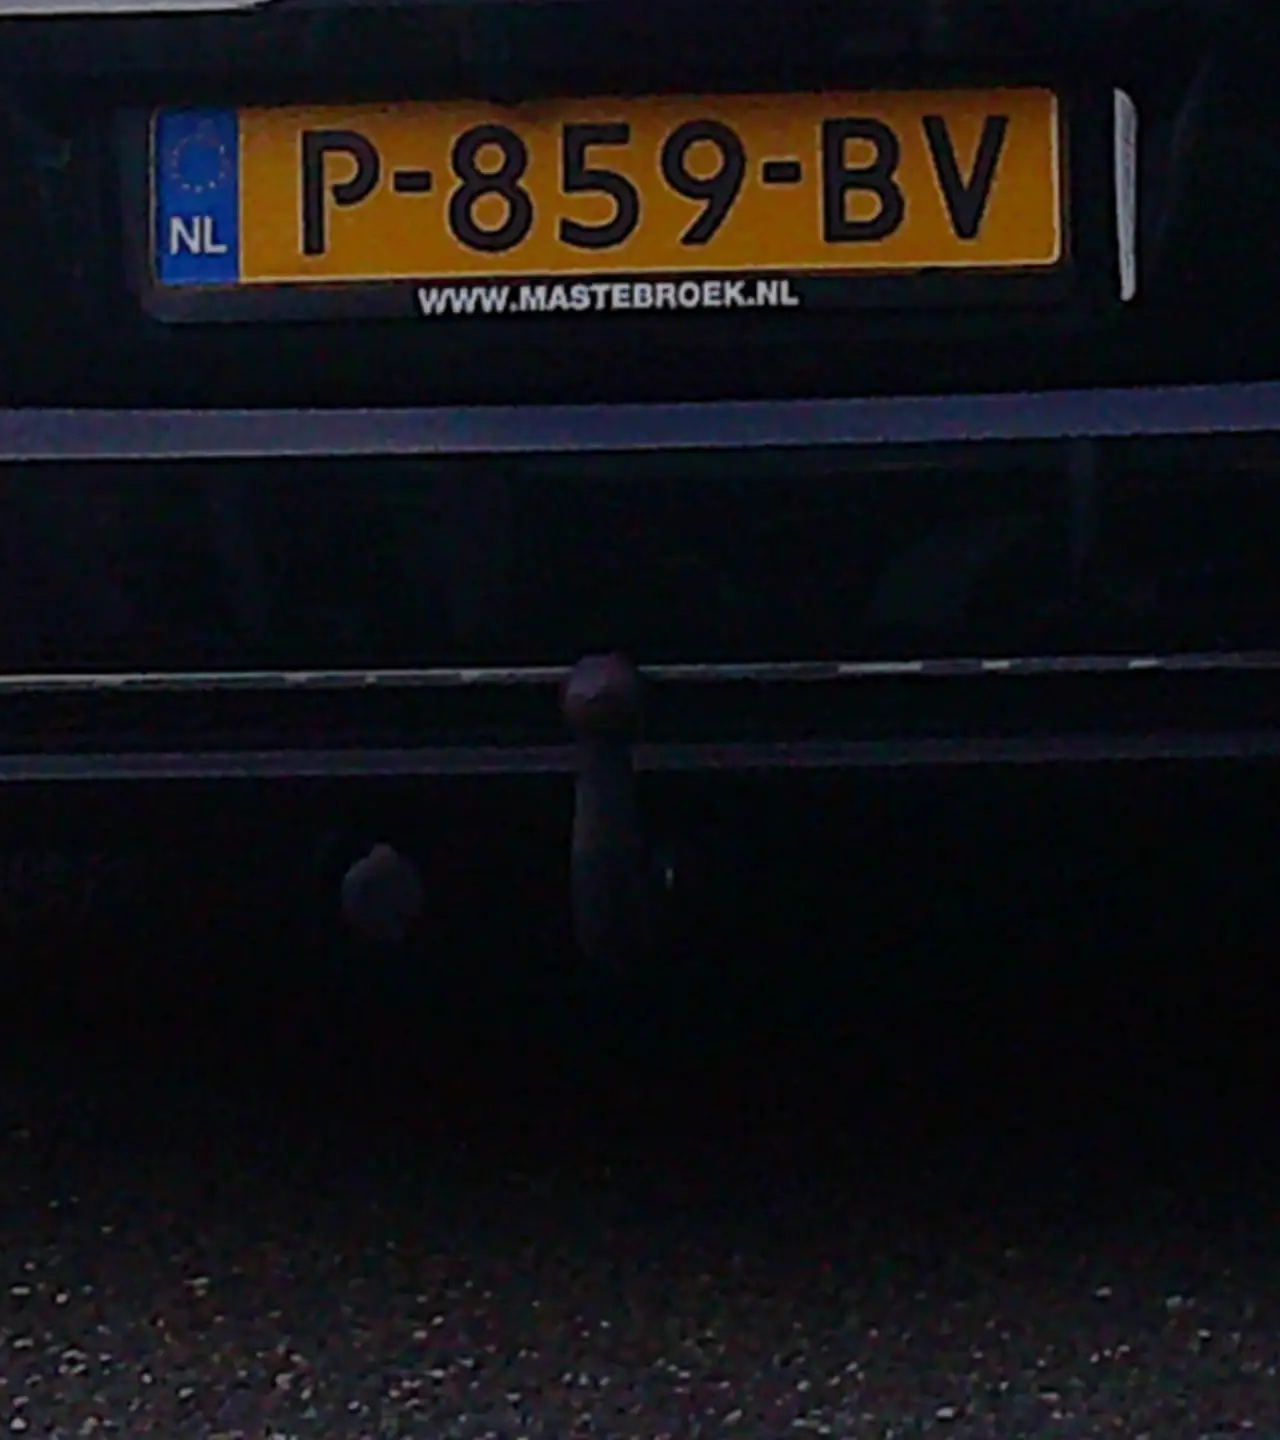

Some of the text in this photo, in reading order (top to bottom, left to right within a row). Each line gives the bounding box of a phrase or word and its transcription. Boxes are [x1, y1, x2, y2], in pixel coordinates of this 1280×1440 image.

[301, 116, 1008, 255] P-859-BV
[170, 215, 228, 255] NL
[419, 281, 799, 315] WWW.MASTEBROEK.NL
